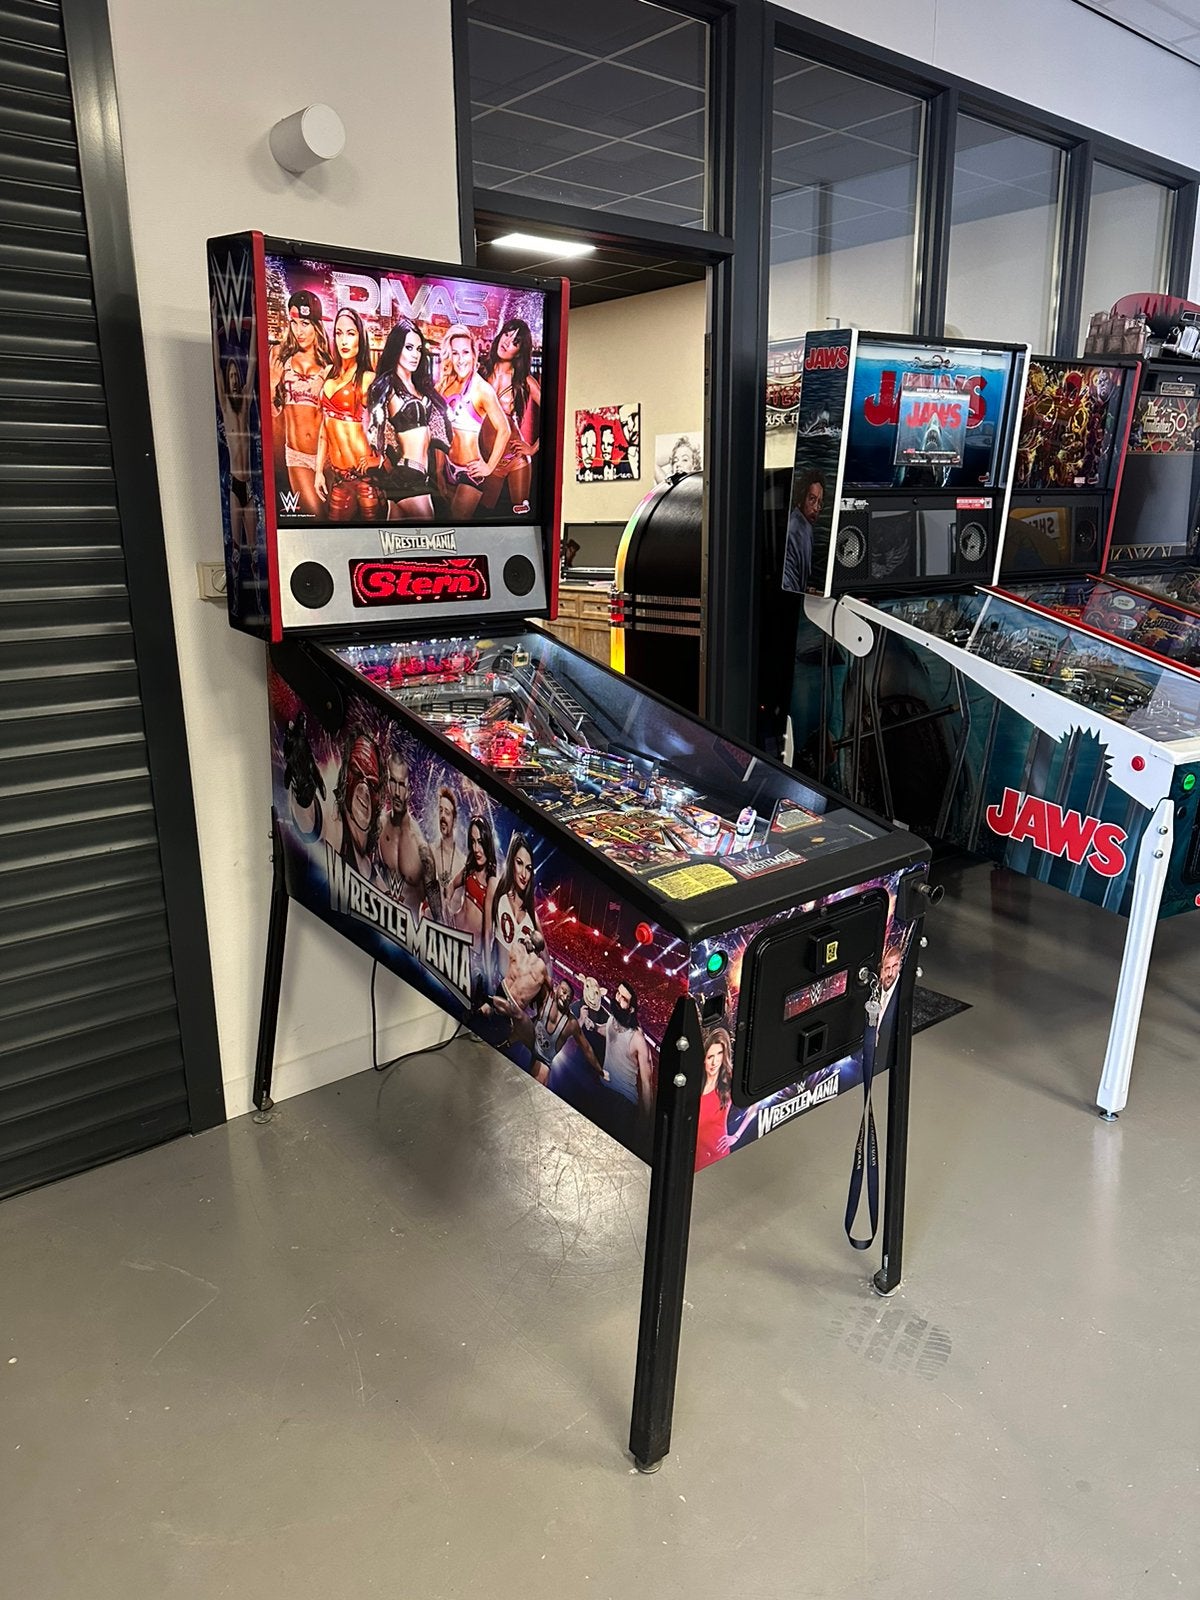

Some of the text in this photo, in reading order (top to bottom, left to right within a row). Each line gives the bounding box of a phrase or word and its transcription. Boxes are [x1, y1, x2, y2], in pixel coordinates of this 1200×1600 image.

[332, 271, 489, 327] DIVAS
[804, 345, 849, 371] JAWS
[905, 401, 963, 429] JAWS
[1167, 412, 1188, 437] 50
[379, 529, 458, 556] WRESTLEMANIA
[368, 570, 474, 598] Stern
[986, 786, 1129, 878] JAWS
[324, 841, 474, 1006] WRESTLEMANIA
[757, 1068, 841, 1139] WRESTLEMANIA
